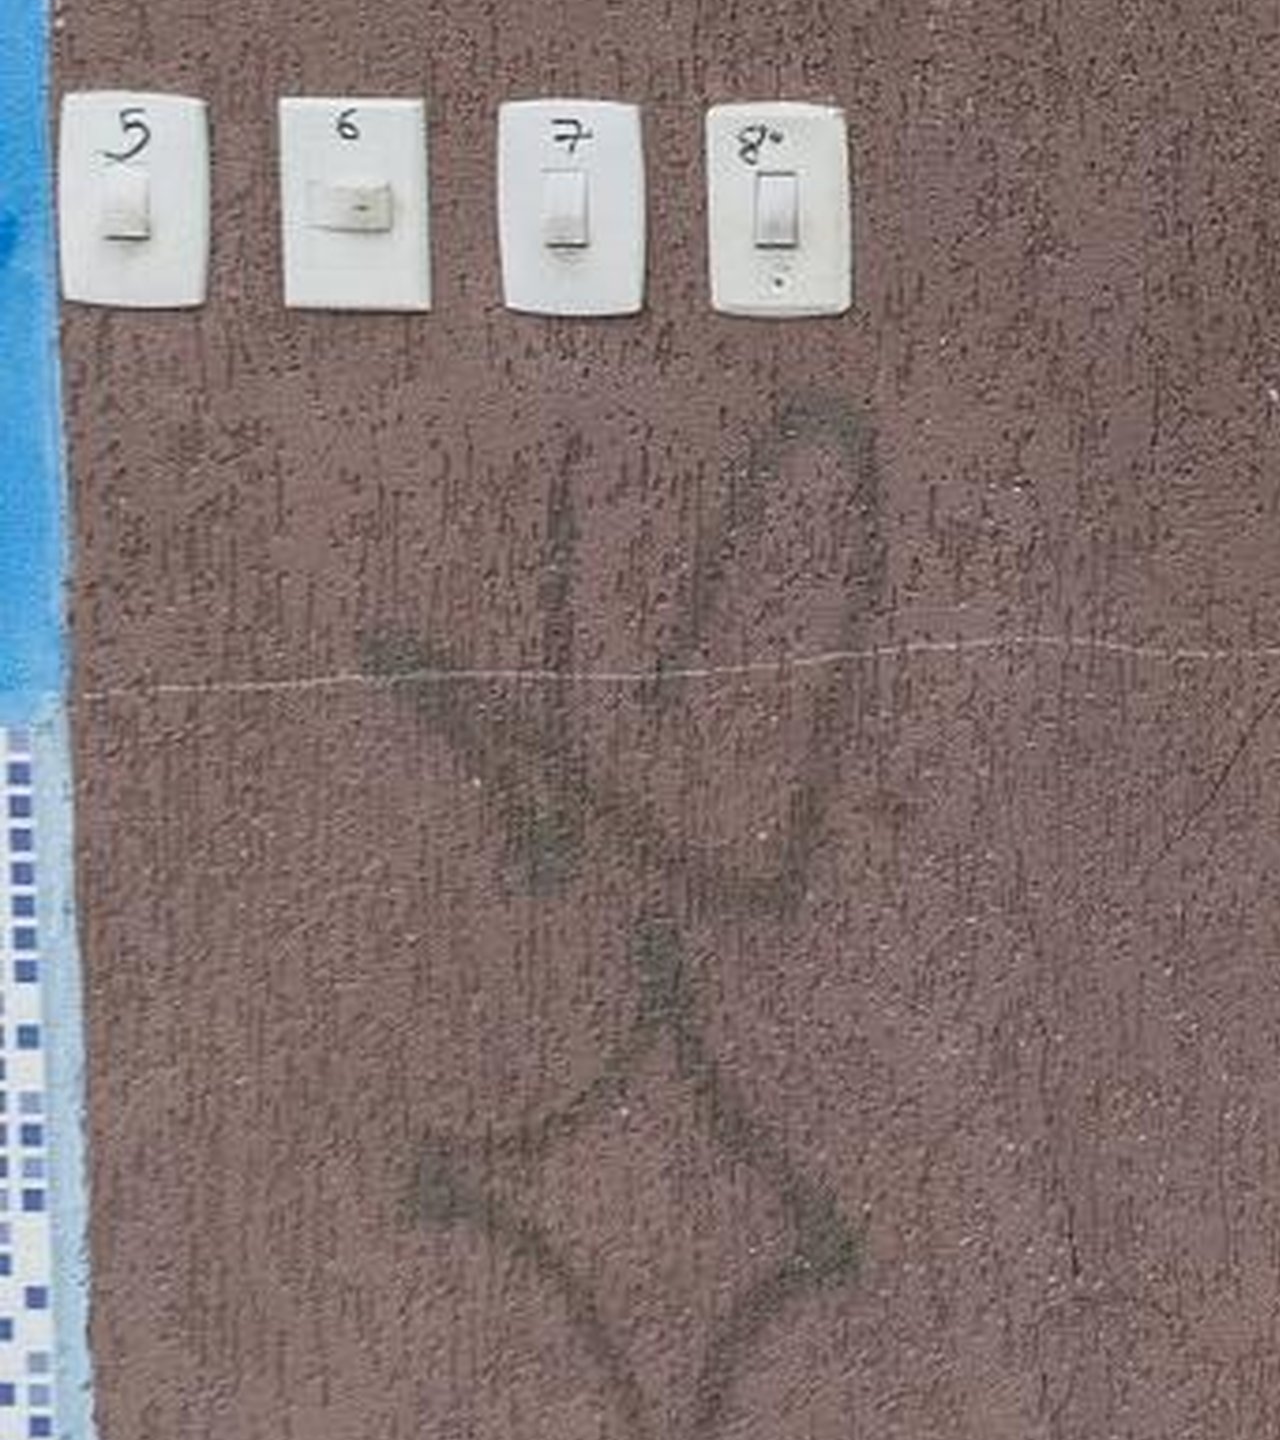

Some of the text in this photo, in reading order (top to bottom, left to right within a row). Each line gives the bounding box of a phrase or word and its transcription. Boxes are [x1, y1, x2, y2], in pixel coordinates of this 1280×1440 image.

[102, 107, 152, 163] 5
[335, 107, 361, 141] 6
[550, 117, 594, 155] 7
